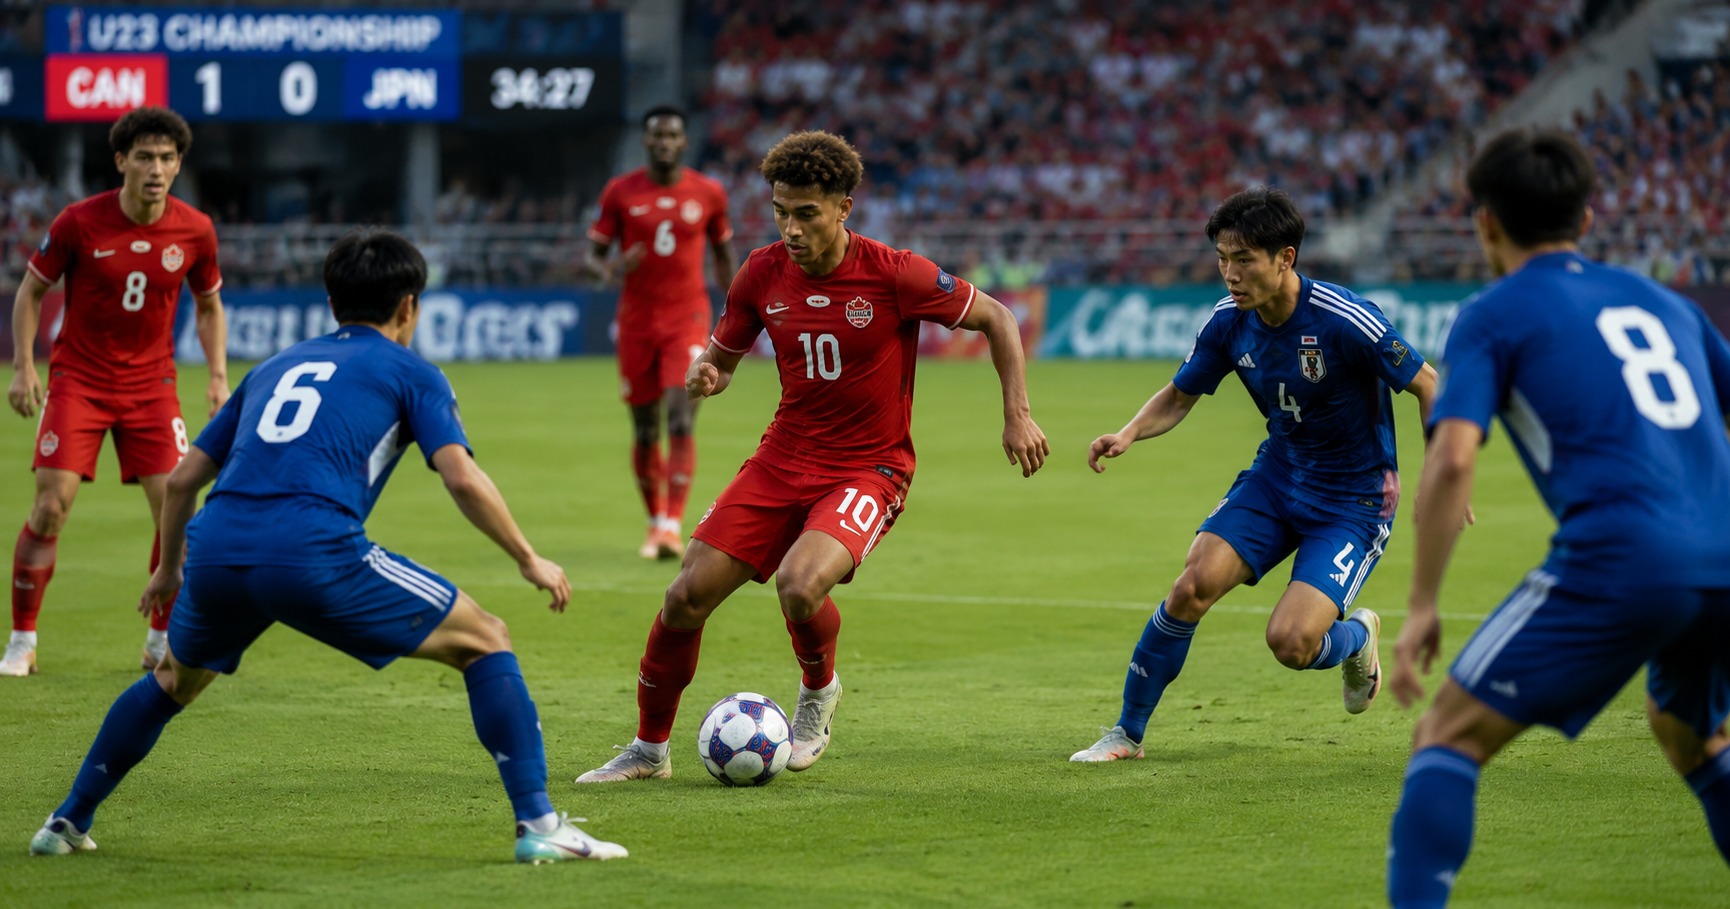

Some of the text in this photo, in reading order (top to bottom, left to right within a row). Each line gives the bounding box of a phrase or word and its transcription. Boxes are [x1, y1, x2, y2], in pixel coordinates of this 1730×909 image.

[87, 13, 442, 52] U23 CHAMPIONSHIP
[66, 60, 595, 116] CAN 1 0 JPN 34:27
[654, 219, 677, 257] 6
[122, 270, 148, 312] 8
[798, 332, 842, 380] 10
[1596, 305, 1701, 430] 8
[256, 361, 338, 444] 6
[1278, 382, 1302, 422] 4
[171, 416, 189, 454] 8
[836, 487, 879, 533] 10
[1332, 542, 1355, 588] 4
